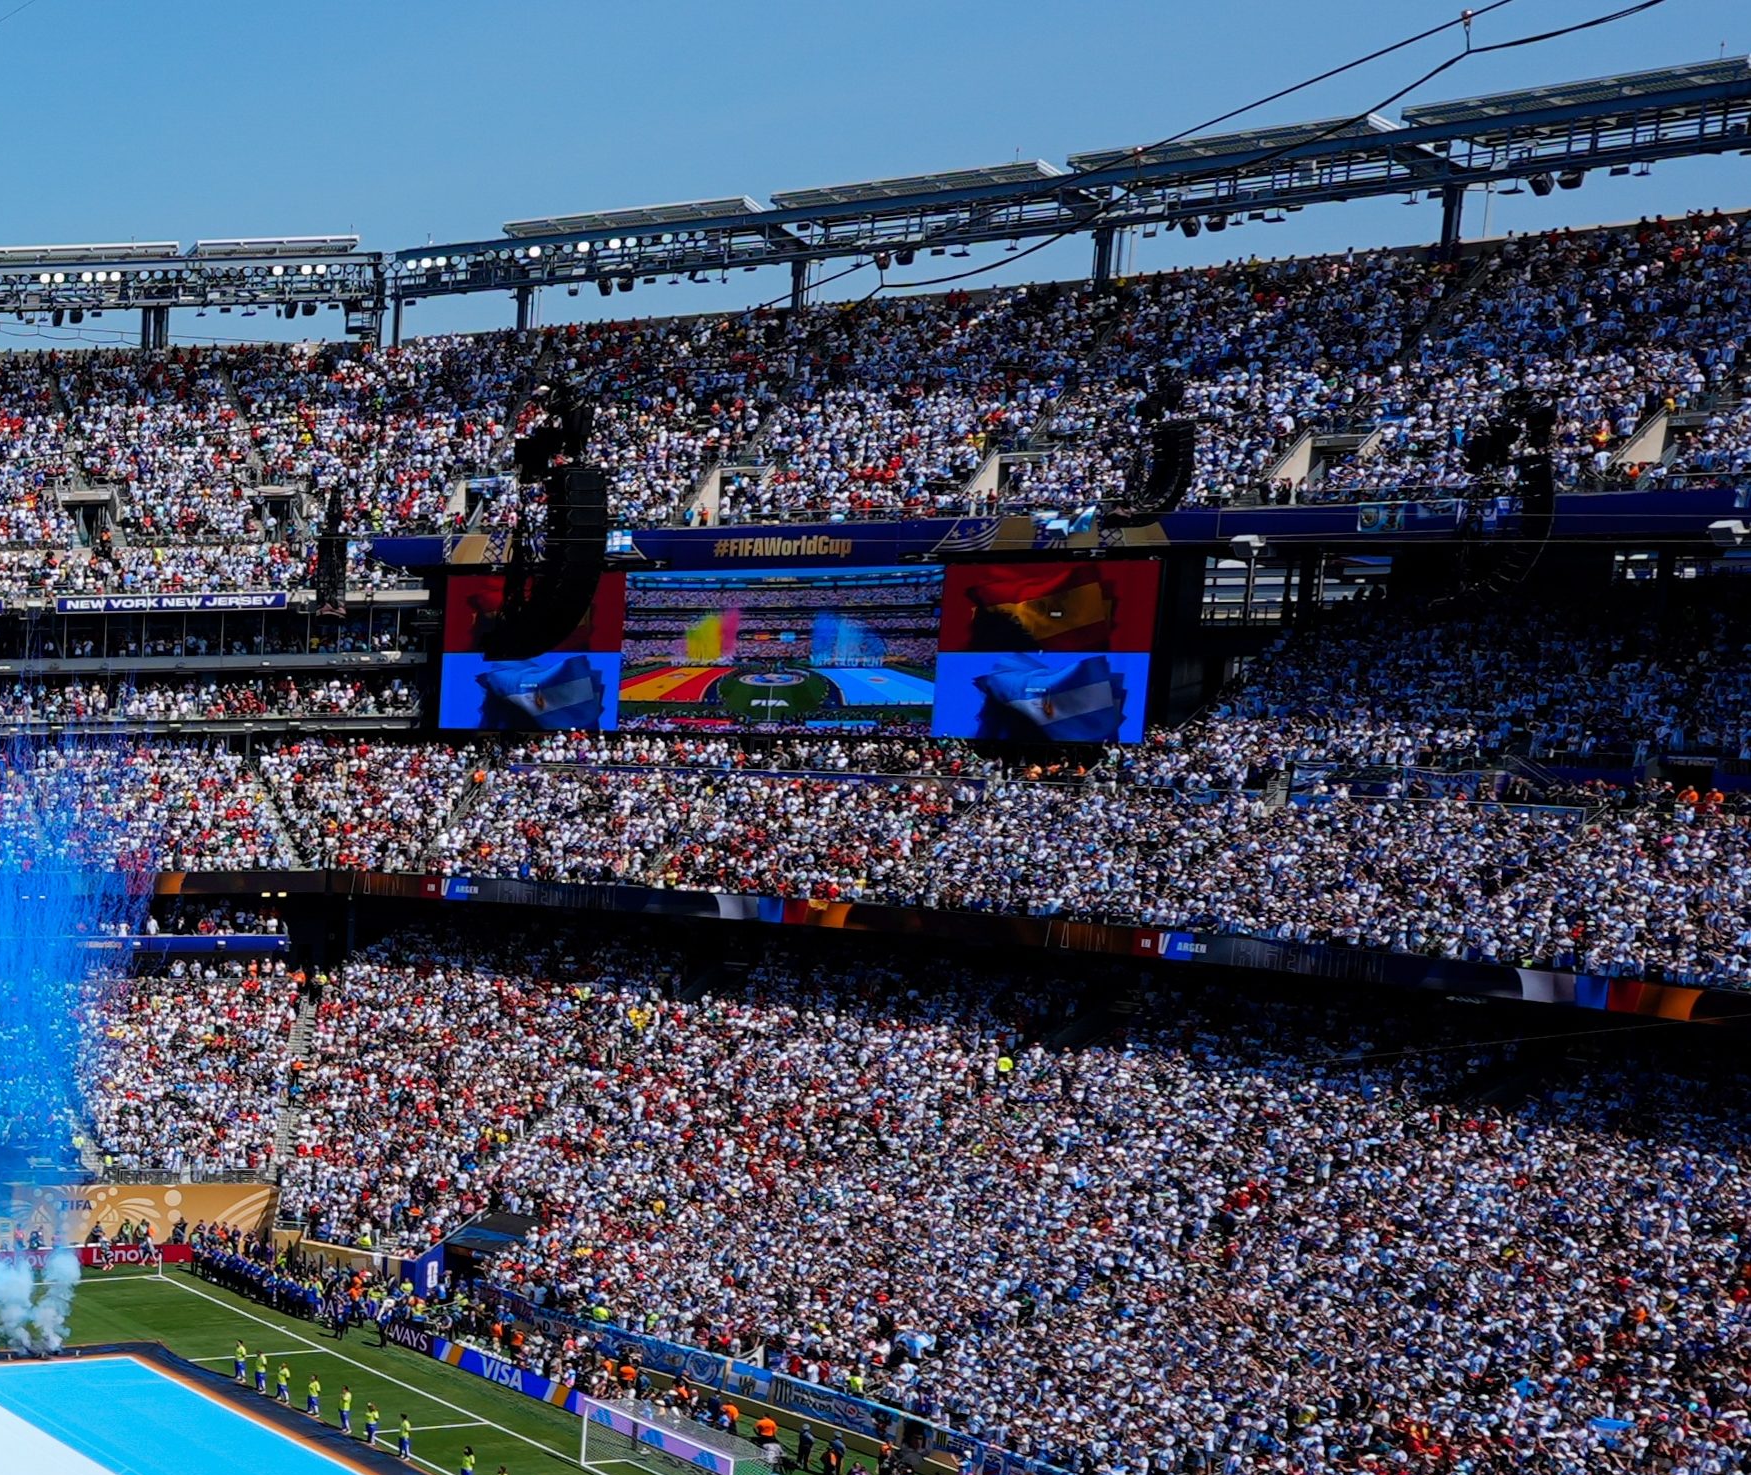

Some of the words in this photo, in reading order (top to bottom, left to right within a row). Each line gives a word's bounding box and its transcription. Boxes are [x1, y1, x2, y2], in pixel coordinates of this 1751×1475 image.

[713, 535, 852, 558] #FIFAWorldCup
[66, 600, 108, 610] NEW
[110, 599, 160, 609] YORK
[162, 598, 204, 608] NEW
[205, 596, 277, 607] JERSEY
[60, 1199, 92, 1211] FIFA
[92, 1248, 158, 1264] Lenov
[478, 1353, 524, 1392] VISA
